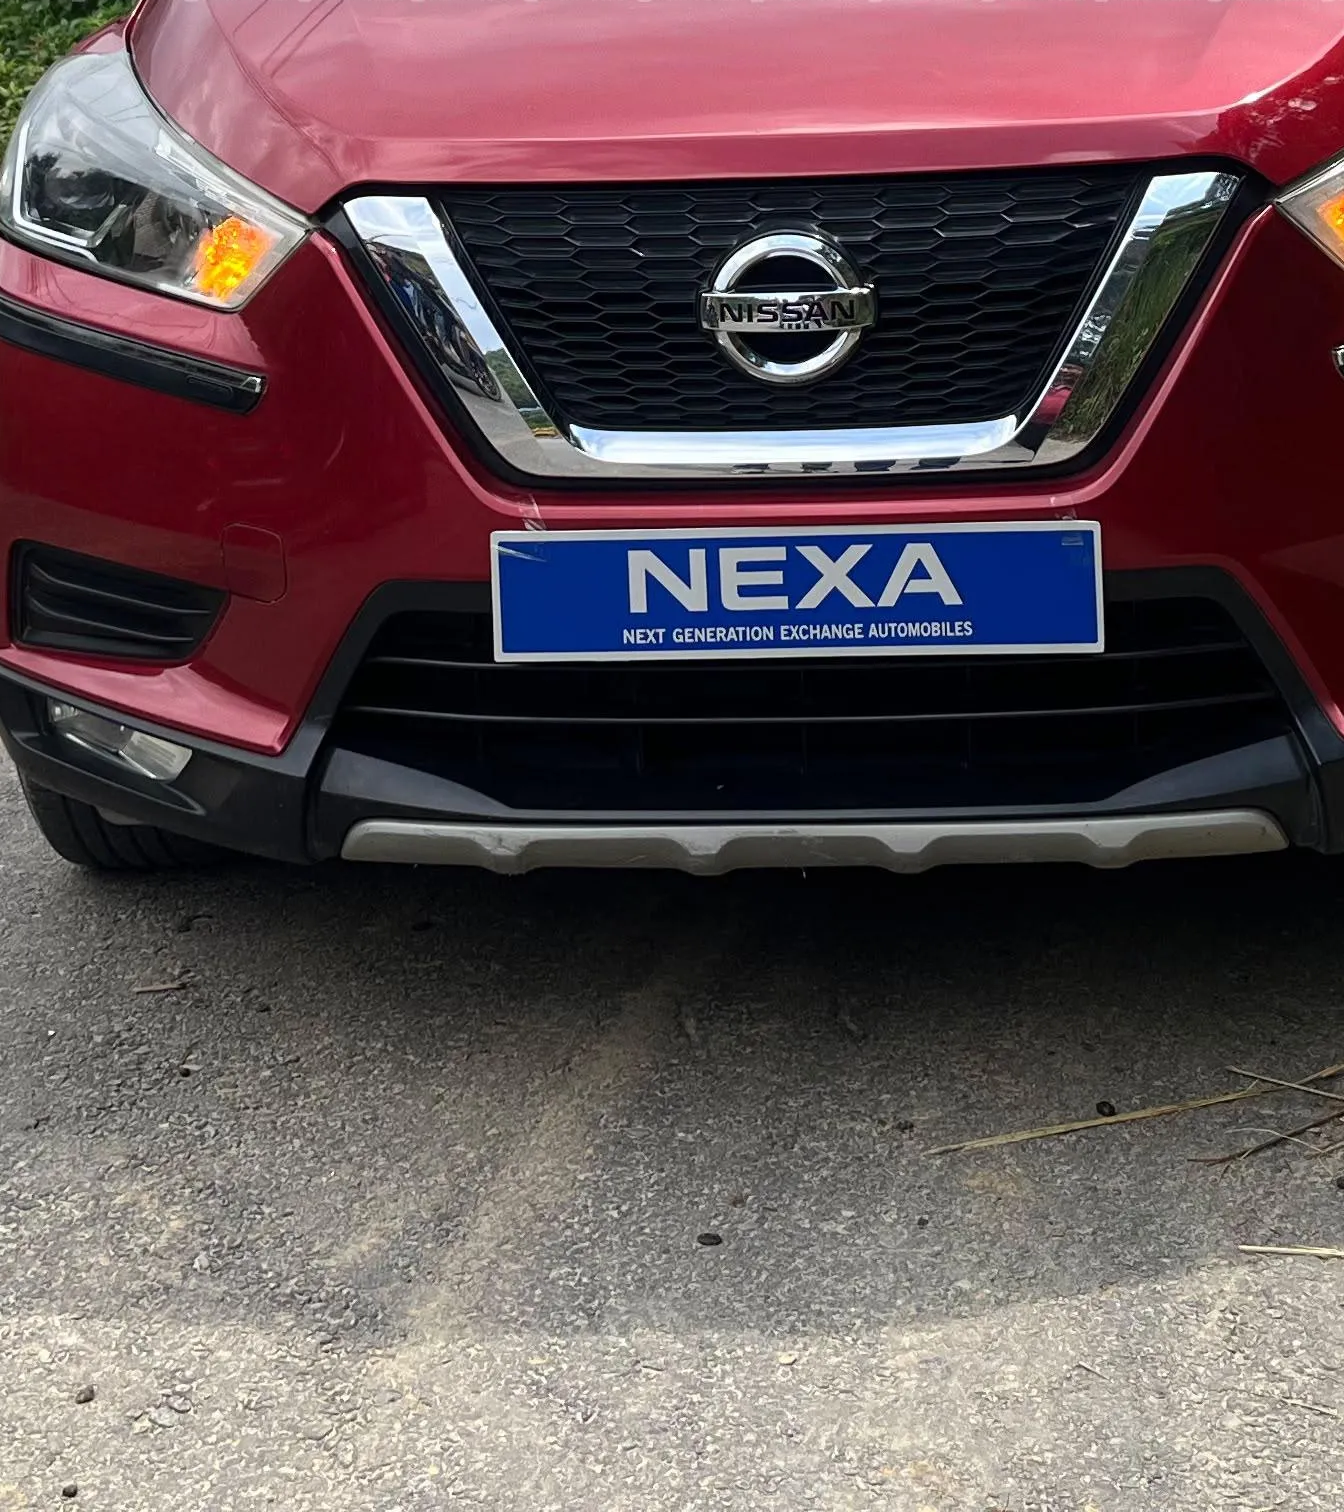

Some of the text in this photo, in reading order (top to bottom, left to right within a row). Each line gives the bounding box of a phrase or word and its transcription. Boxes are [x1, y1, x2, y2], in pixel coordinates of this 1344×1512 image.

[719, 299, 855, 323] NISSAN
[627, 542, 964, 614] NEXA
[622, 620, 973, 645] NEXT GENERATION EXCHANGE AUTOMOBILES
